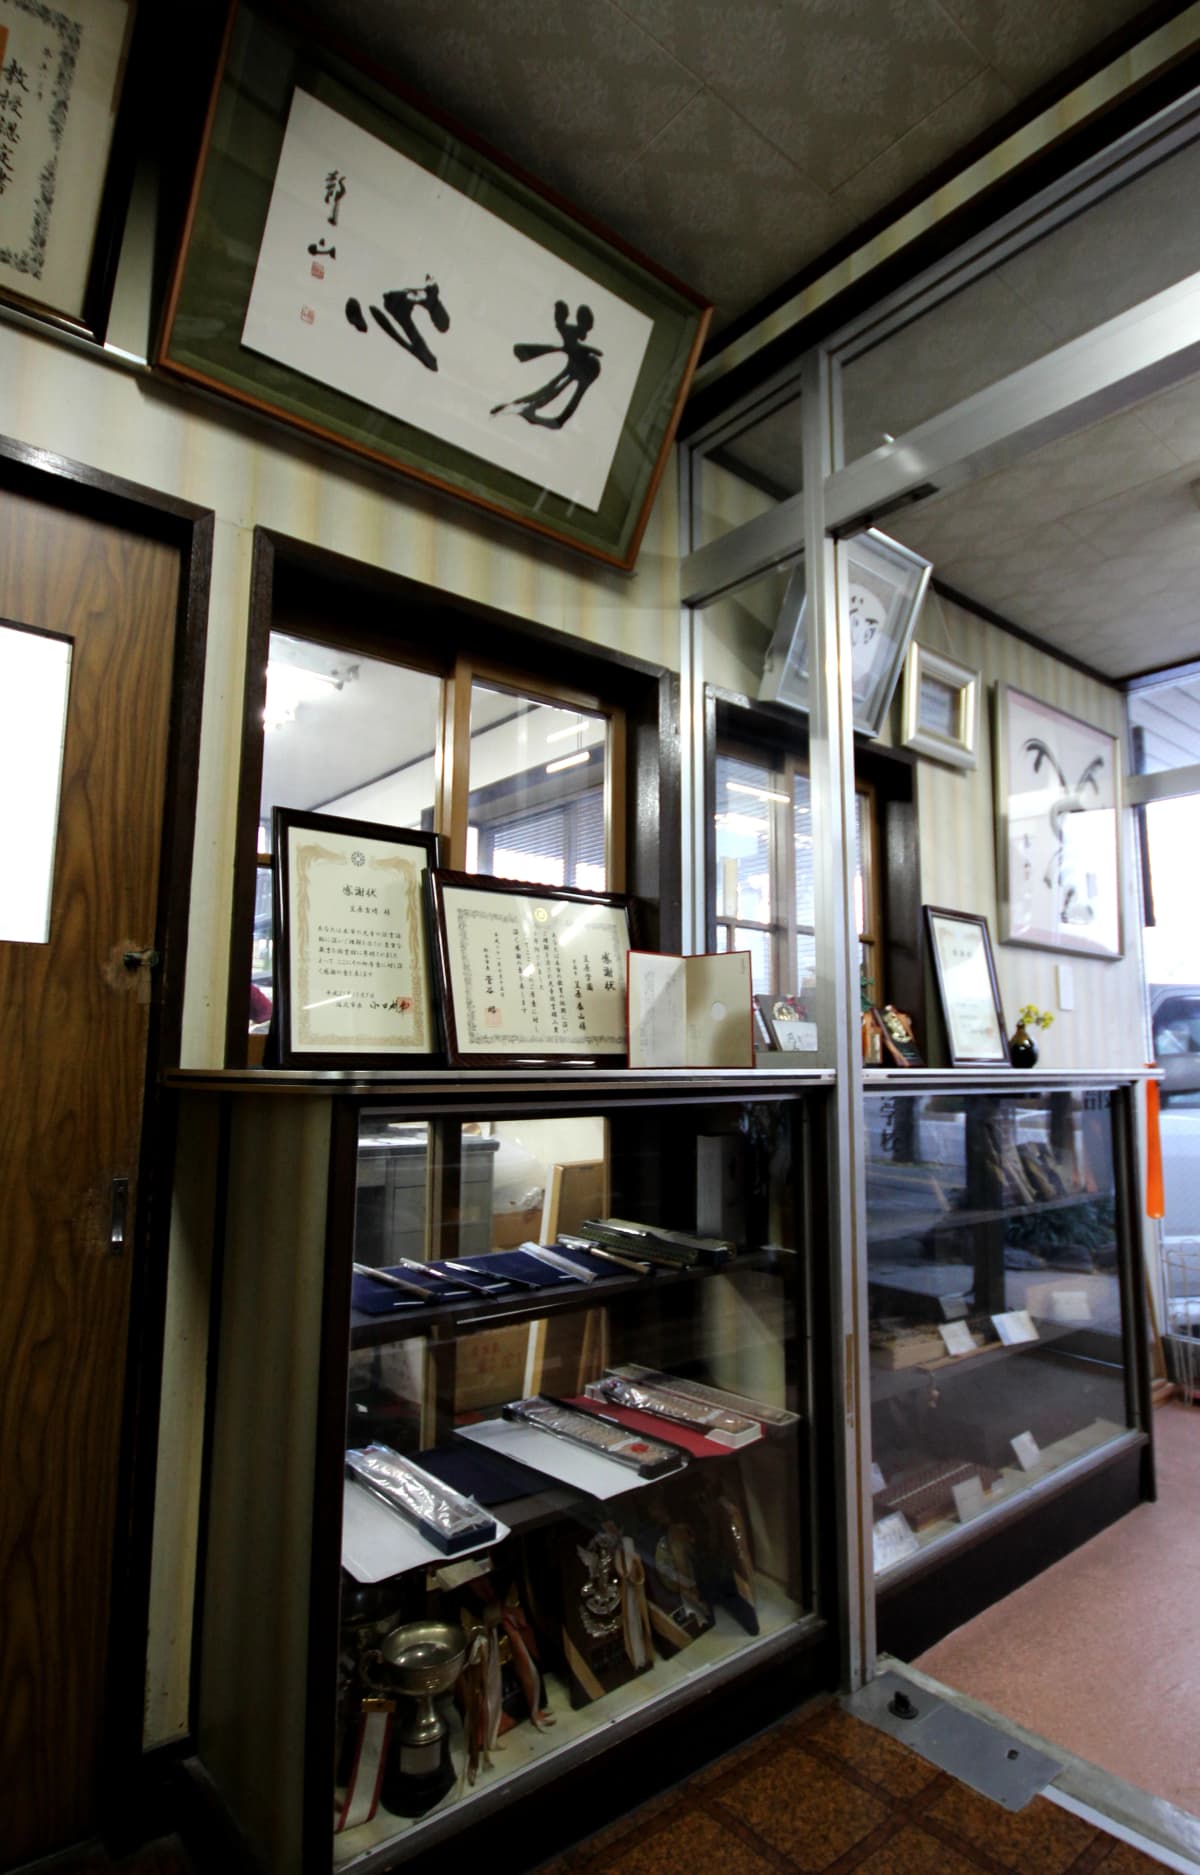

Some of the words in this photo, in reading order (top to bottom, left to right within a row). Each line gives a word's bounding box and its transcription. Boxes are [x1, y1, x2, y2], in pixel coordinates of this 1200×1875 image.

[342, 884, 377, 898] 感謝状
[601, 951, 617, 992] 感謝状
